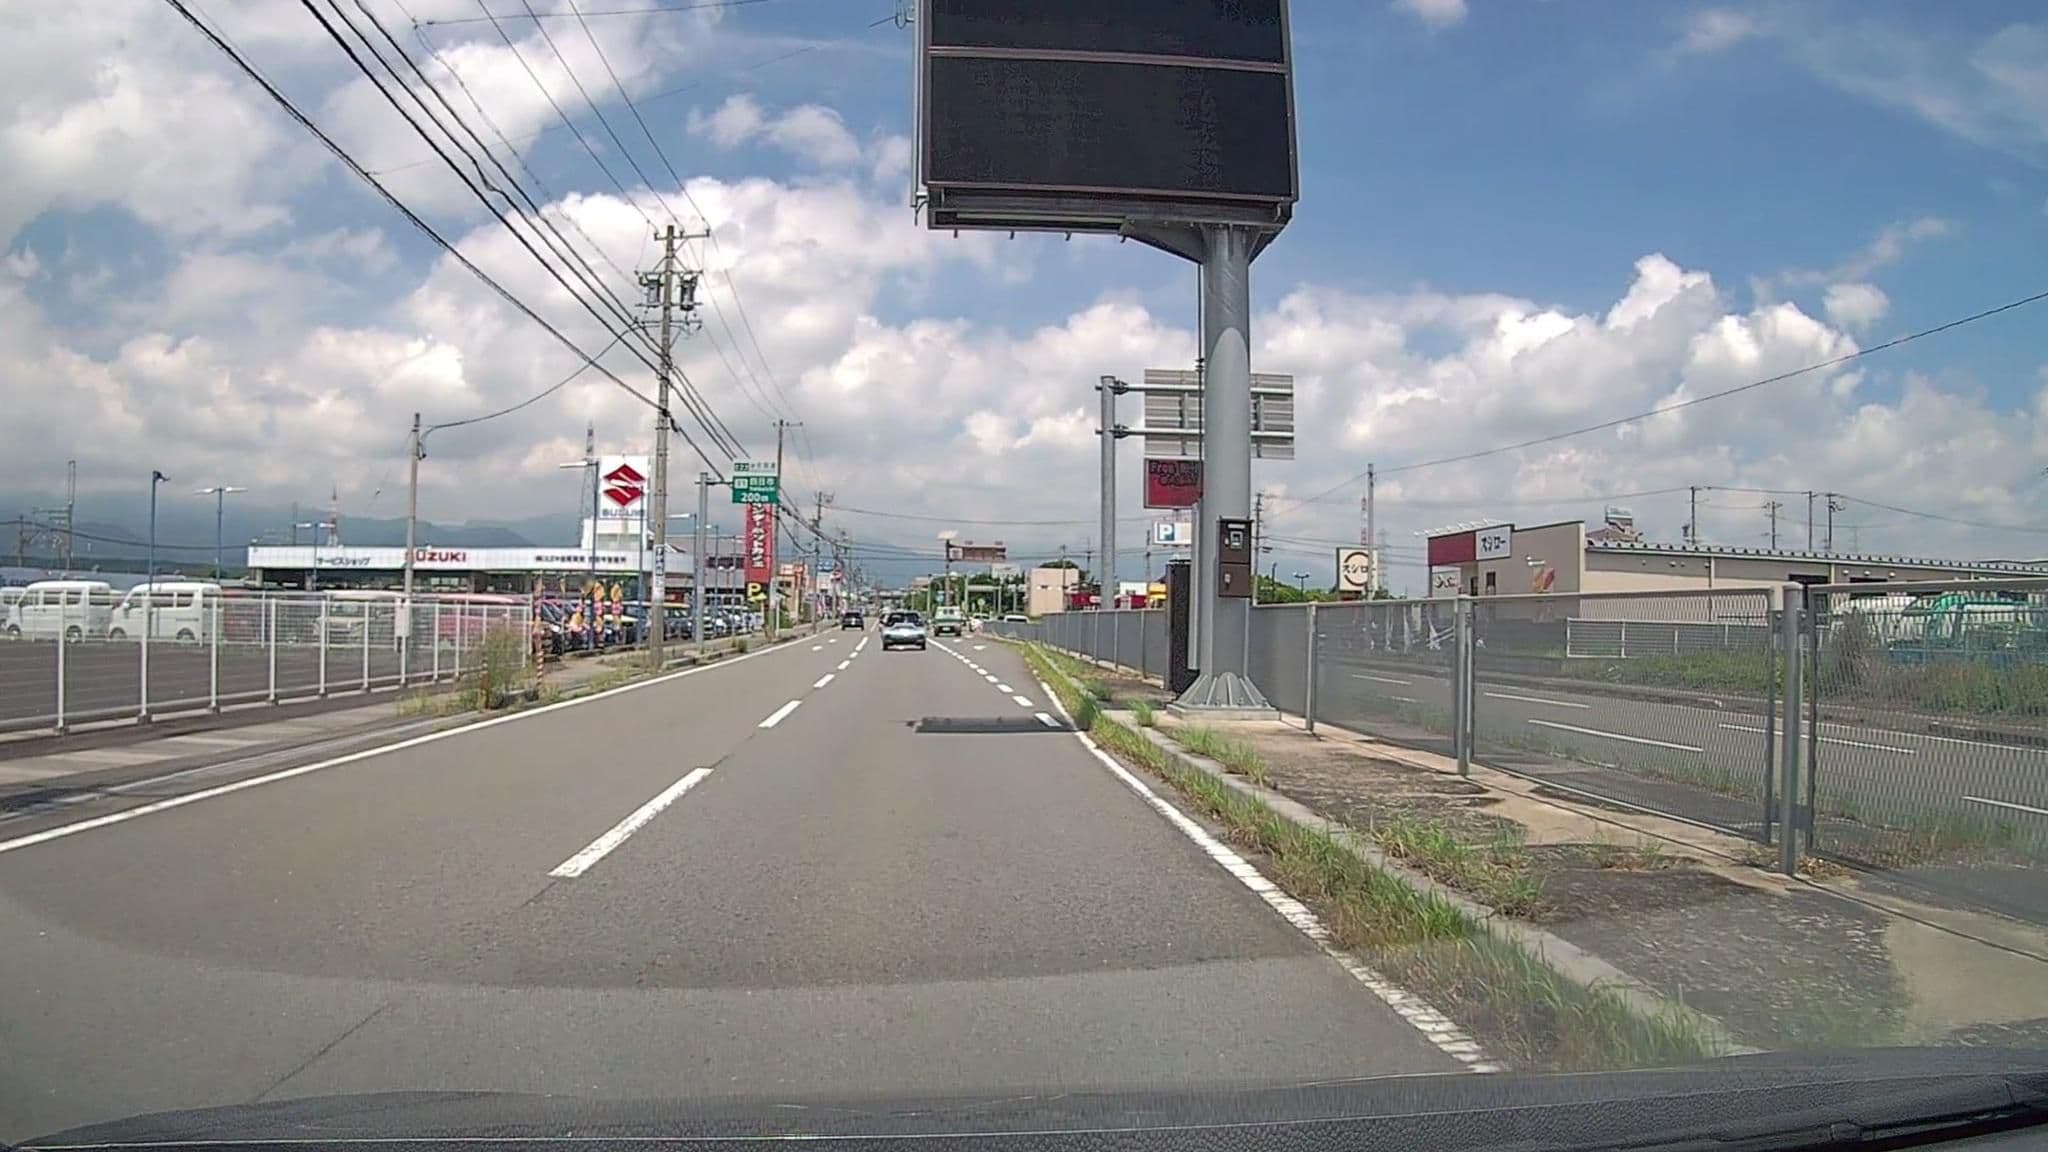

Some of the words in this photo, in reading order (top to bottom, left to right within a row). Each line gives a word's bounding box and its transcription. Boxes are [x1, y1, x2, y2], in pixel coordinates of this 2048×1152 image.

[741, 492, 769, 502] 200m
[405, 551, 467, 562] UZUKI
[747, 582, 762, 597] P
